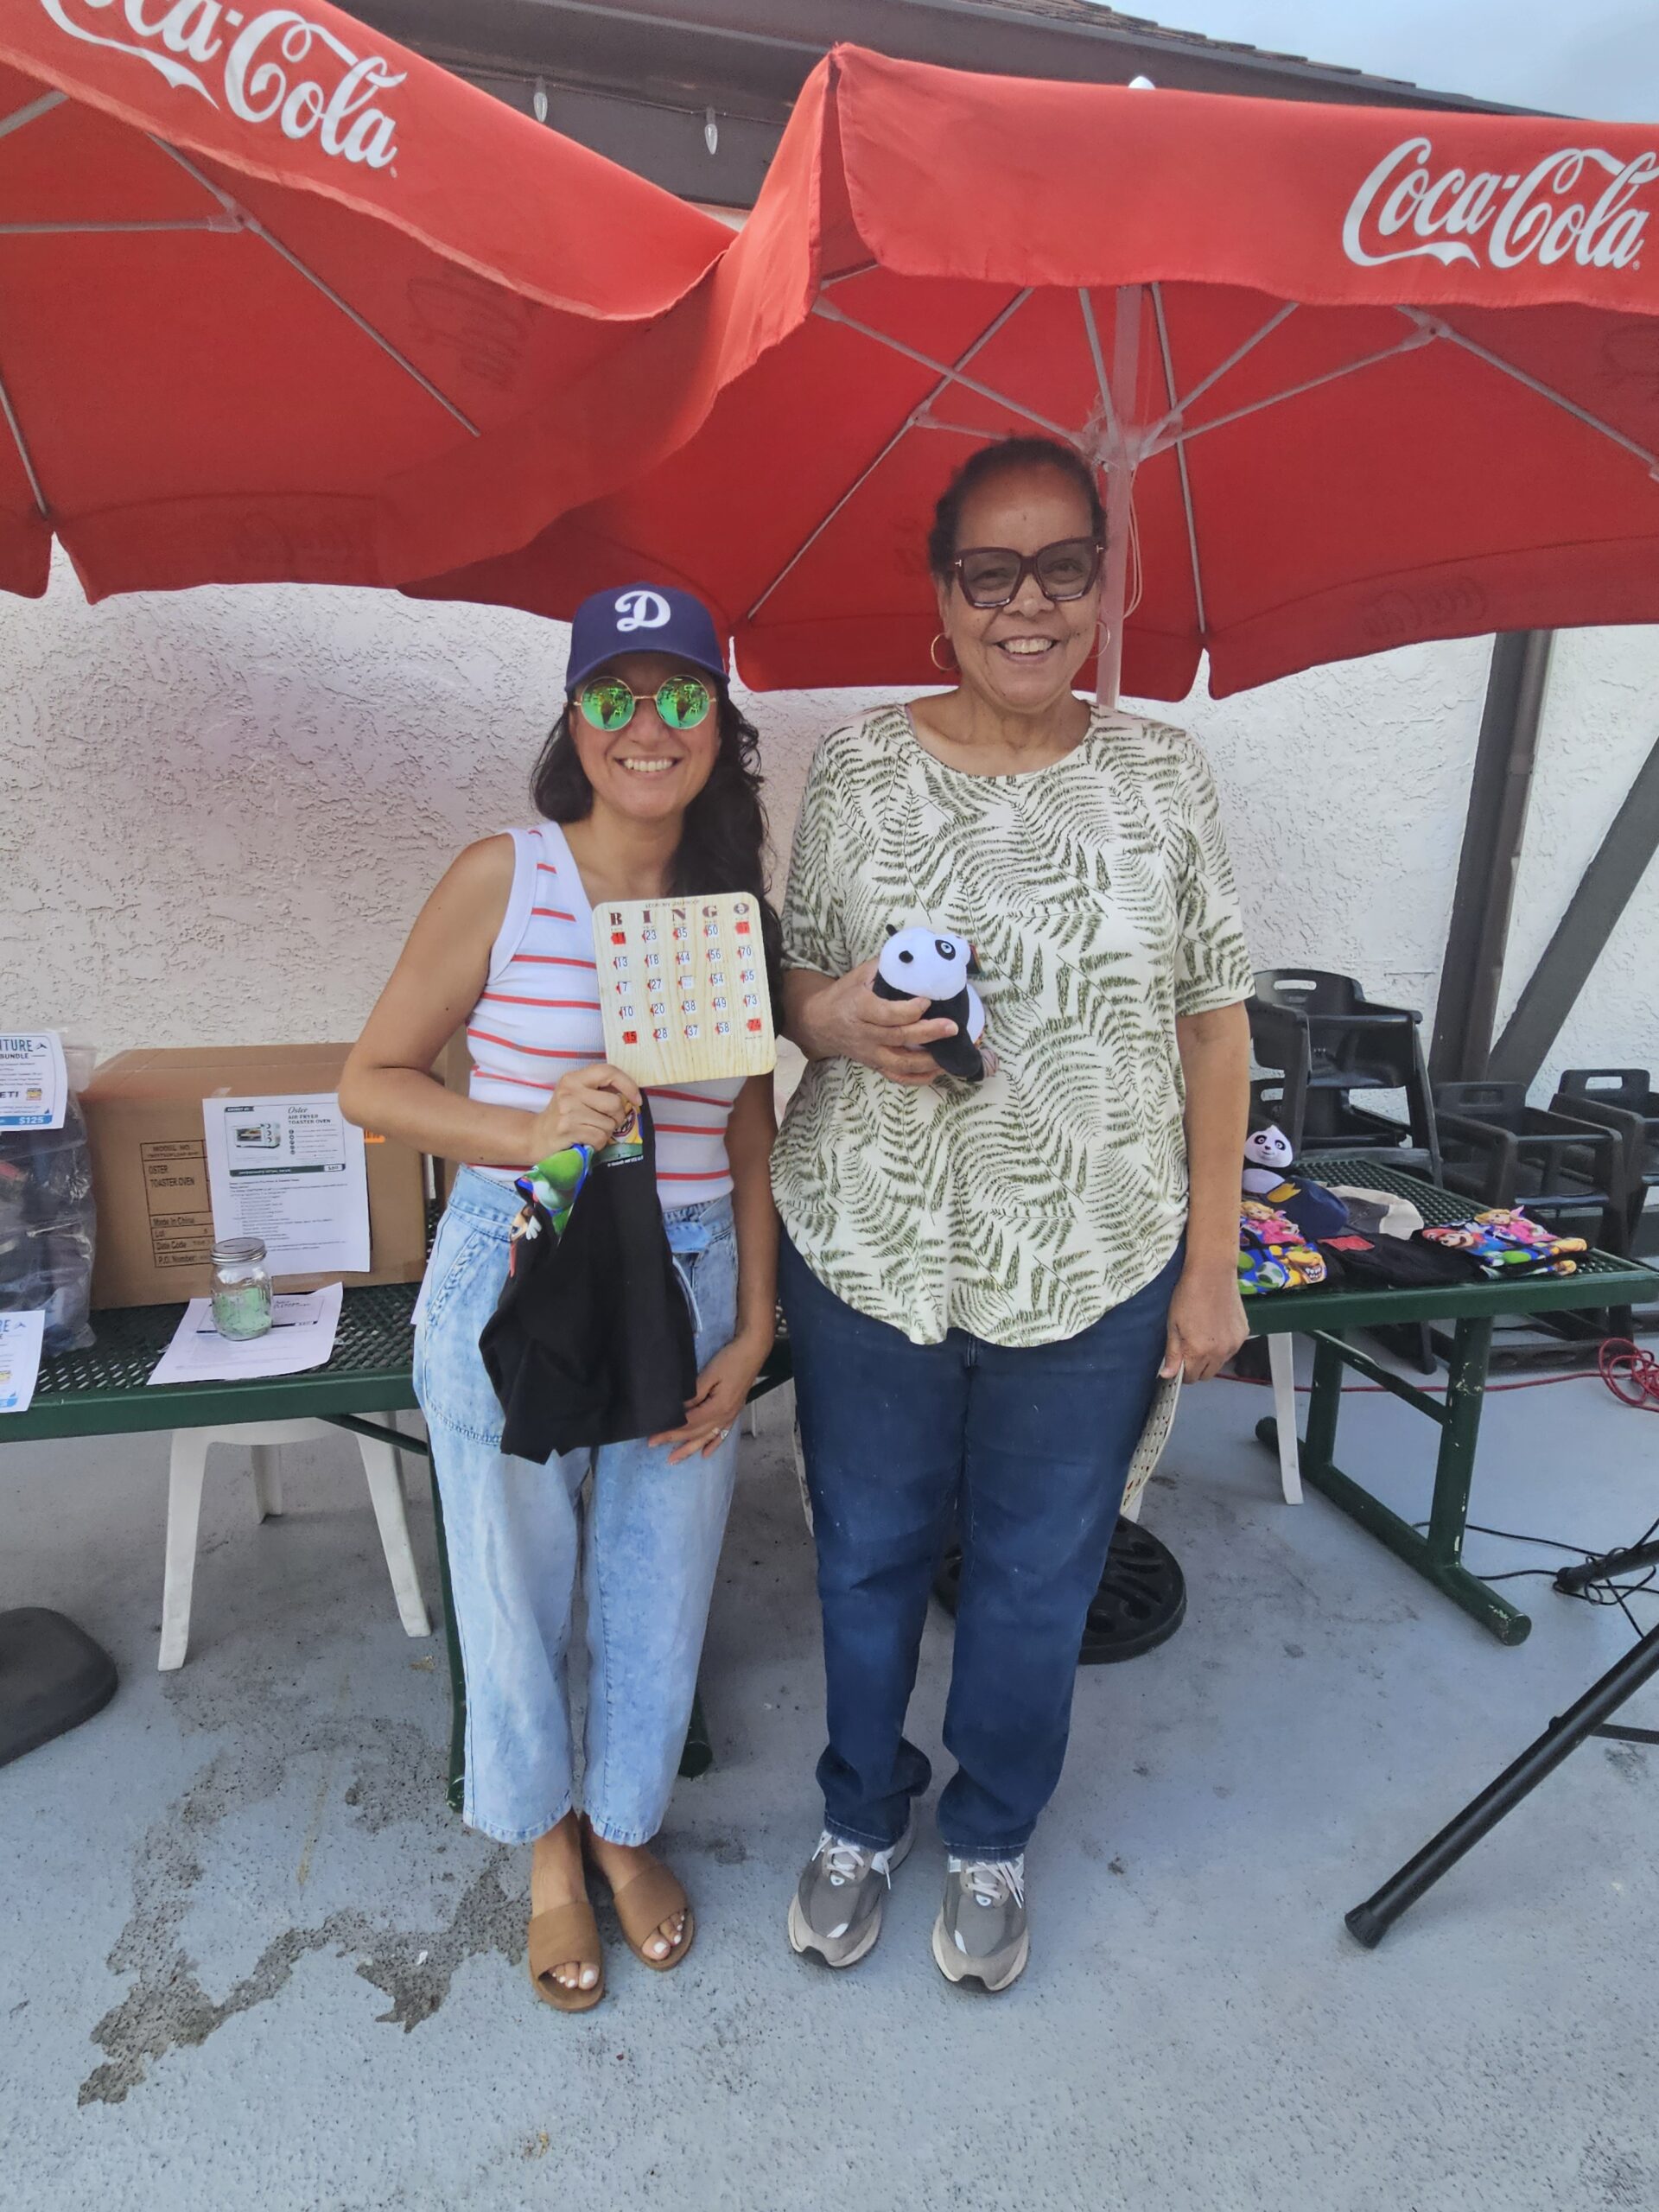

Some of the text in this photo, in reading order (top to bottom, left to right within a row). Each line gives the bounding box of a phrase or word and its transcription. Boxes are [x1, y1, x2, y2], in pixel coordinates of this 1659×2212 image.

[1342, 137, 1659, 270] Coca-Cola
[614, 590, 671, 632] D
[645, 930, 658, 940] 23
[677, 927, 688, 938] 35
[708, 925, 718, 935] 50
[618, 946, 752, 967] 13 18 44 56 70
[622, 982, 628, 992] 7
[651, 979, 662, 989] 27
[713, 973, 723, 983] 54
[623, 995, 758, 1017] 10 20 38 49 73
[657, 1027, 668, 1039] 28
[688, 1025, 698, 1036] 37
[718, 1022, 729, 1033] 58
[0, 1039, 34, 1052] TURE
[149, 1165, 168, 1174] OSTER
